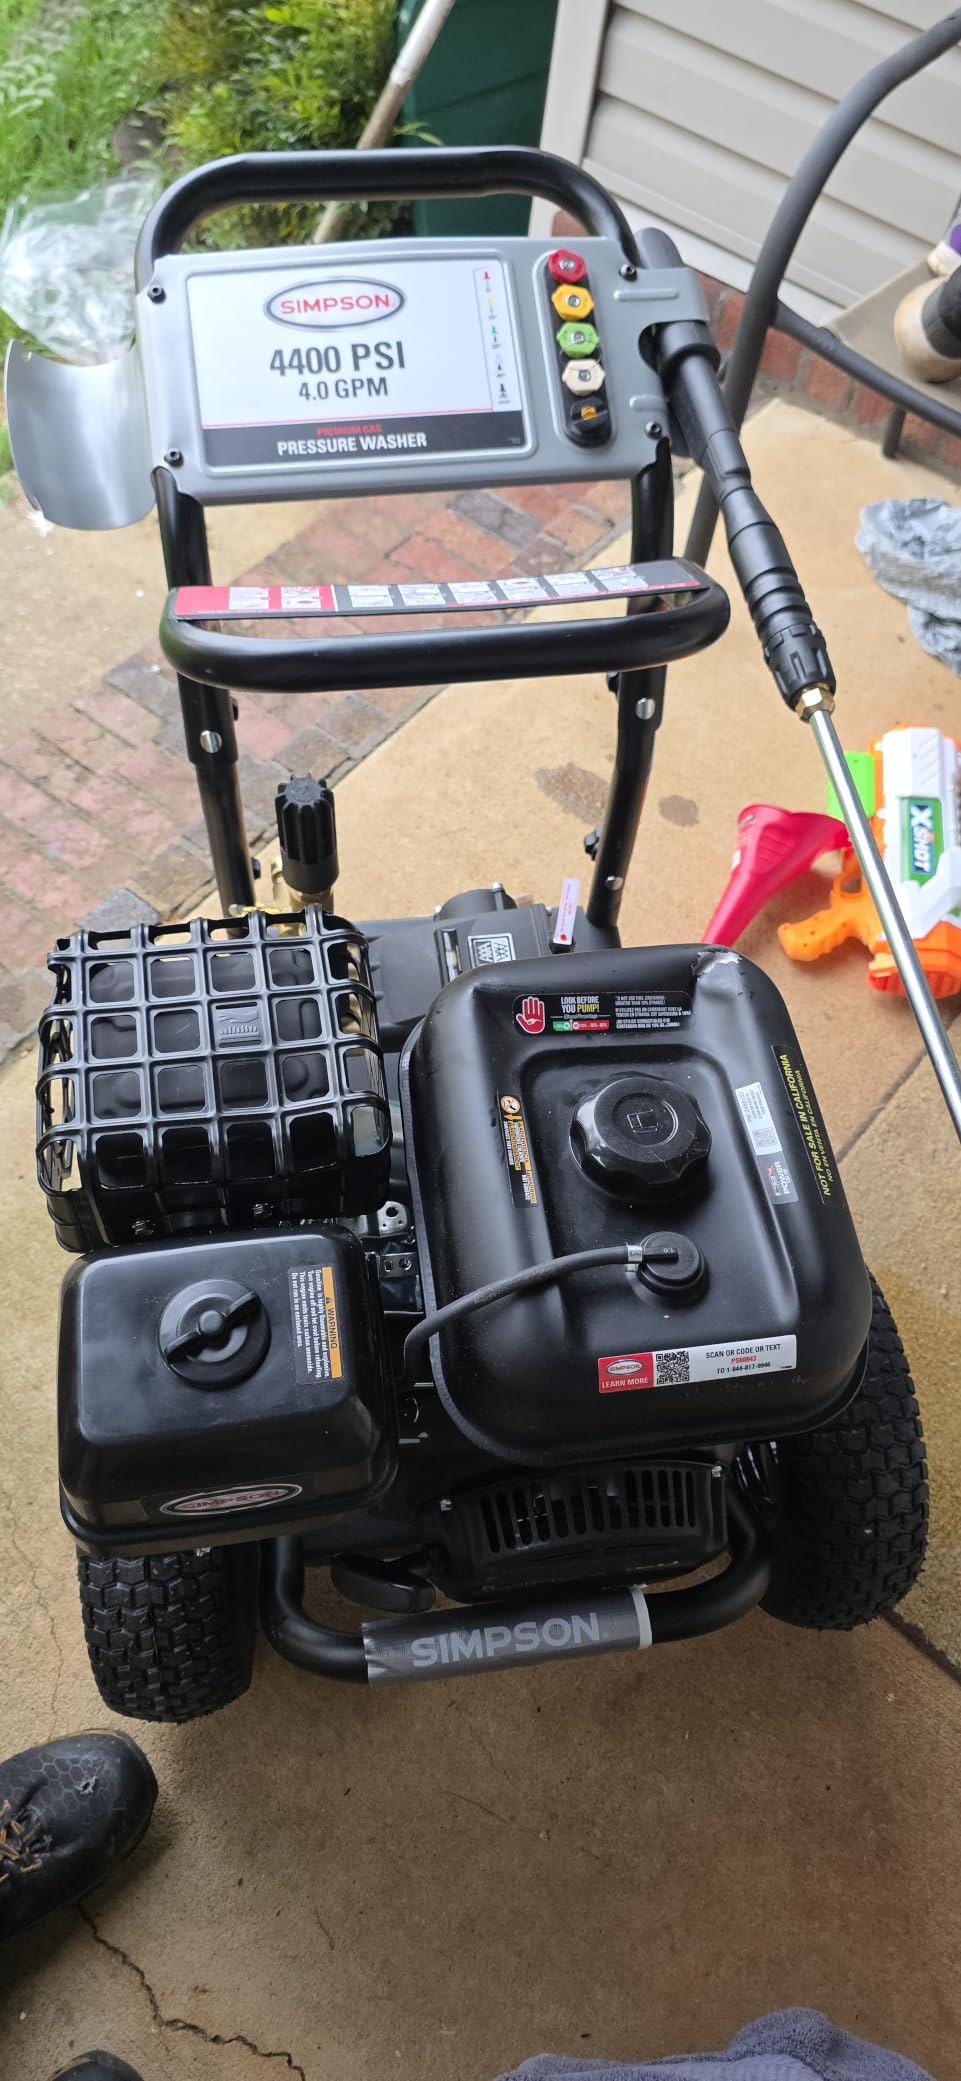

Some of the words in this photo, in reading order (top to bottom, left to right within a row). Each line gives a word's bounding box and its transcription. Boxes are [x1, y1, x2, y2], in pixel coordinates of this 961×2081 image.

[280, 293, 390, 314] SIMPSON
[270, 346, 341, 376] 4400
[351, 341, 405, 371] PSI
[299, 381, 329, 400] 4.0
[335, 376, 388, 399] GPM
[277, 436, 357, 456] PRESSURE
[359, 432, 427, 450] WASHER
[560, 996, 576, 1005] LOOK
[576, 995, 599, 1004] BEFORE
[561, 1004, 576, 1013] YOU
[577, 1003, 600, 1013] PUMP!
[780, 1054, 803, 1109] CALIFORNIA
[798, 1111, 808, 1122] IN
[802, 1124, 816, 1149] SALE
[811, 1151, 823, 1171] FOR
[822, 1156, 829, 1167] EN
[818, 1172, 831, 1195] NOT
[826, 1169, 833, 1181] NO
[327, 1308, 337, 1349] WARNING
[706, 1350, 724, 1358] SCAN
[736, 1346, 754, 1355] CODE
[755, 1345, 764, 1353] OR
[765, 1343, 781, 1351] TEXT
[610, 1363, 640, 1371] SIMPSON
[602, 1380, 626, 1388] LEARN
[627, 1377, 648, 1385] MORE
[182, 1490, 282, 1509] SIMPSON
[410, 1612, 600, 1667] SIMPSON
